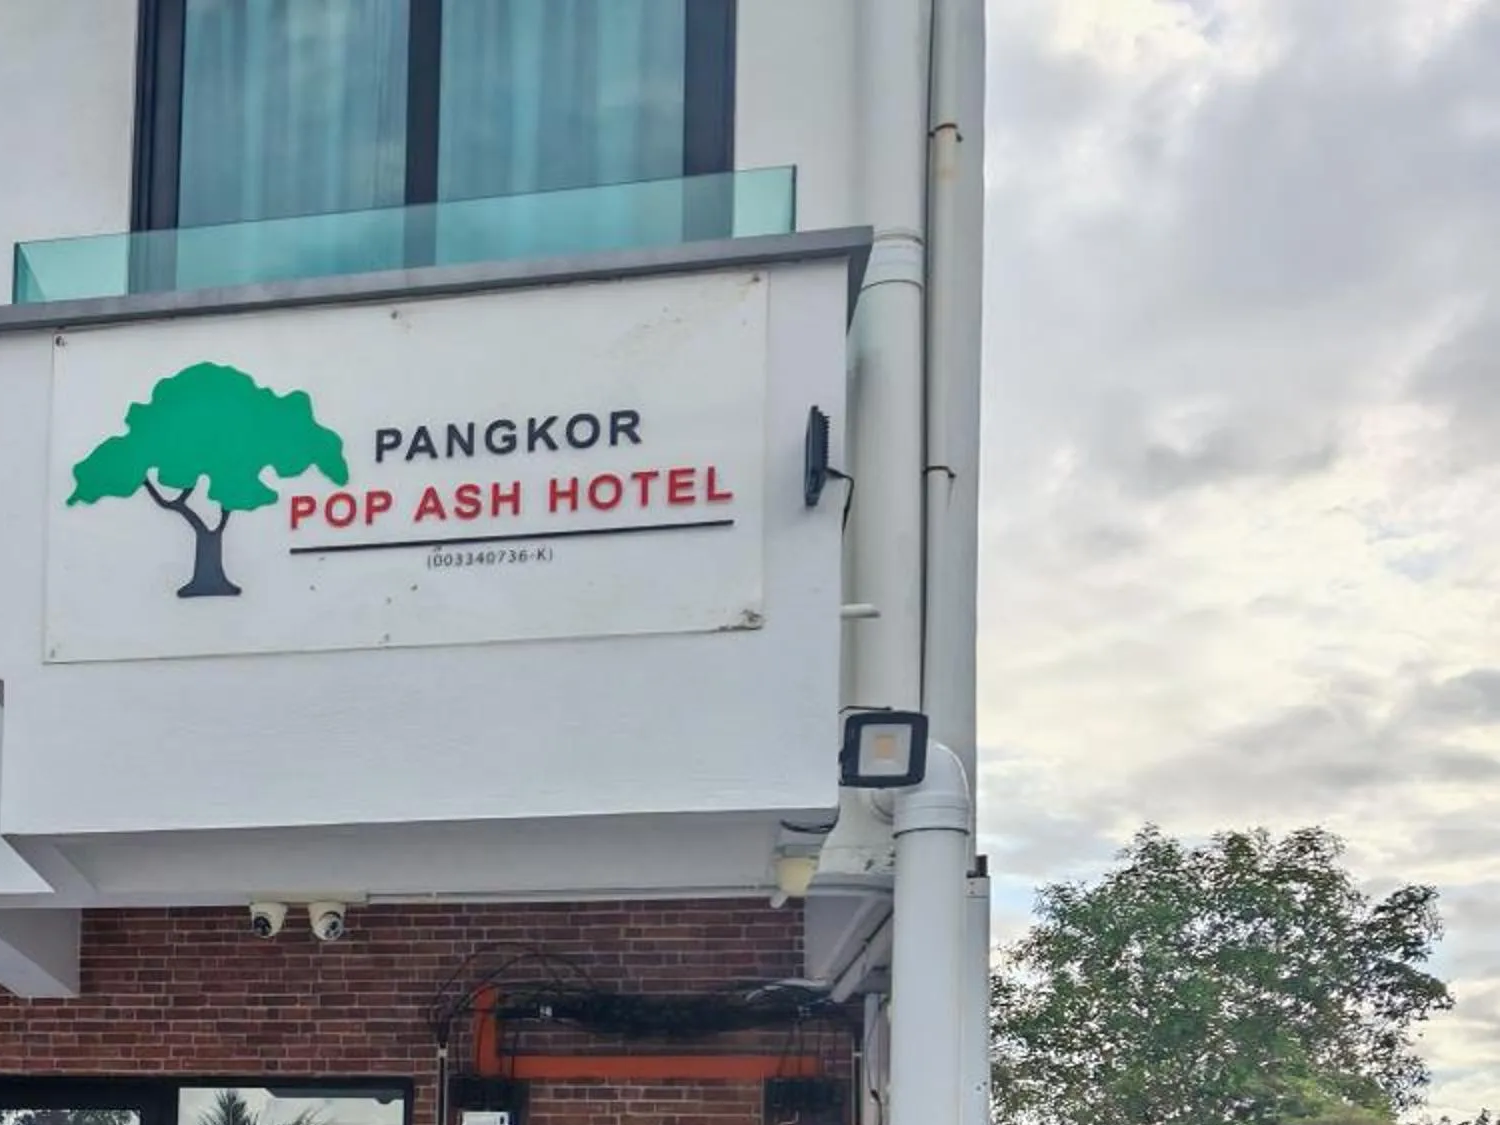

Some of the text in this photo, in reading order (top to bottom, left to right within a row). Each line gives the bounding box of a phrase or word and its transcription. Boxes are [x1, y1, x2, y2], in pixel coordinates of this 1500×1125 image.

[375, 408, 642, 463] PANGKOR
[289, 466, 734, 530] POP ASH HOTEL
